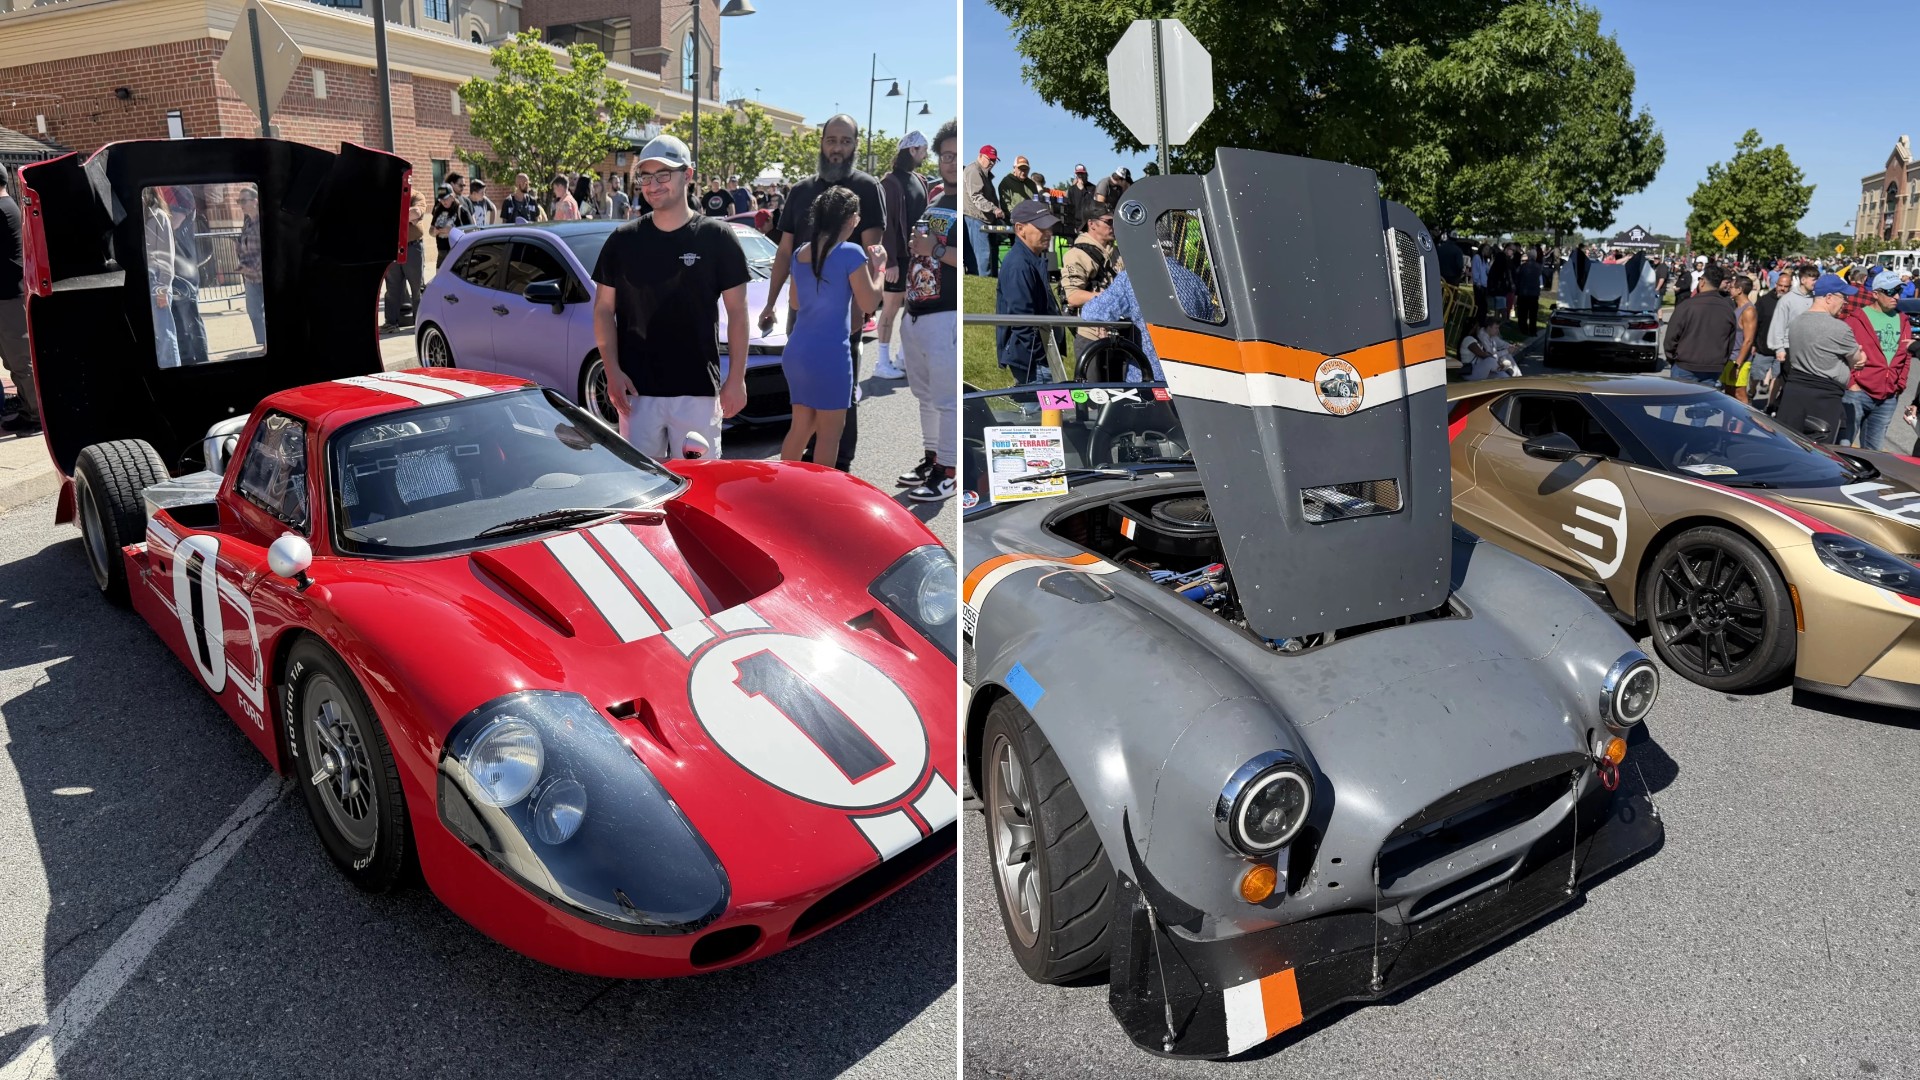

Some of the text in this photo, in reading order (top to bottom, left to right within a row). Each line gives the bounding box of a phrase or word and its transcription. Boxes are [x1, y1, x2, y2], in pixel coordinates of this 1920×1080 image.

[992, 440, 1011, 448] FORD
[186, 549, 214, 676] 1
[237, 692, 264, 730] FORD
[286, 661, 304, 757] Radial T/A
[731, 648, 896, 785] 1
